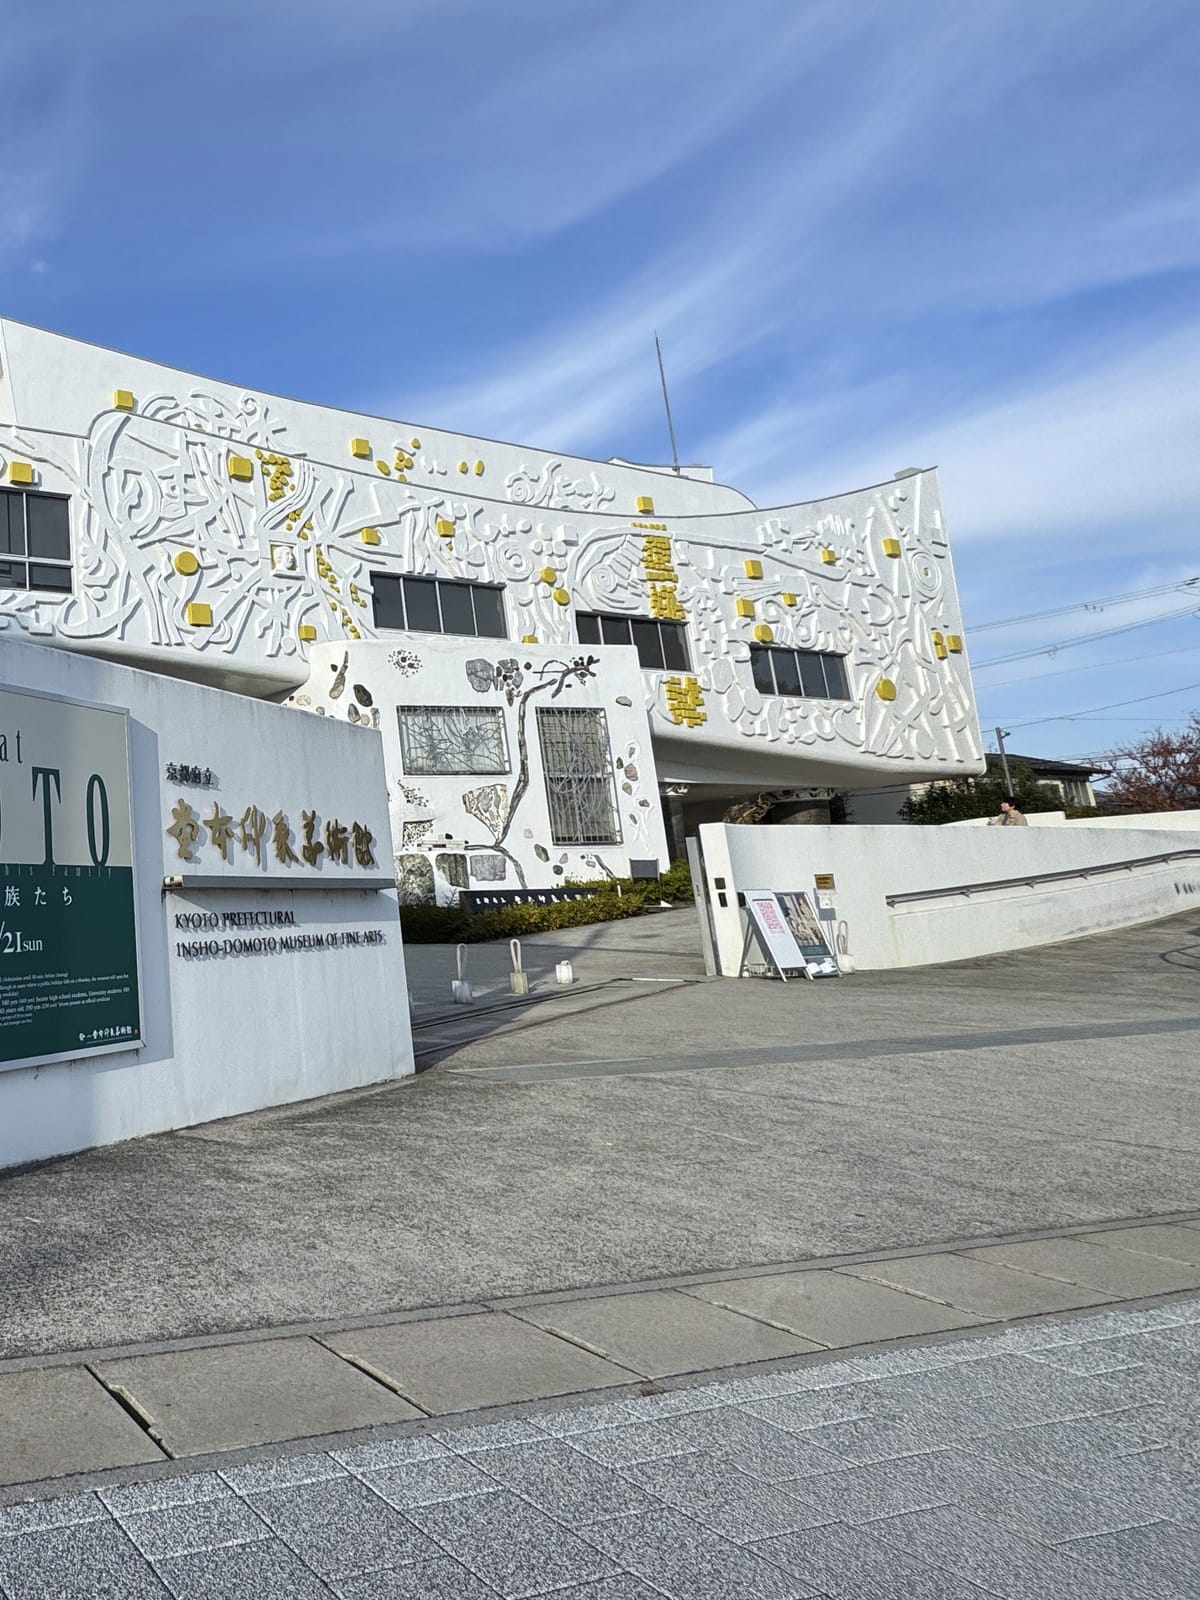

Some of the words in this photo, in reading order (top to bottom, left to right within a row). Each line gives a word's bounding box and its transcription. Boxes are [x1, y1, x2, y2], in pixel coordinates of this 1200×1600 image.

[166, 762, 214, 785] 京都府立
[166, 798, 375, 867] 堂本印象美術館
[175, 912, 219, 929] KYOTO
[222, 911, 296, 927] PREFECTURAL
[176, 936, 277, 958] INSHO-DOMOTO
[279, 933, 325, 950] MUSEUM
[326, 932, 338, 946] OF
[341, 931, 360, 945] FINE
[363, 929, 383, 944] ARTS
